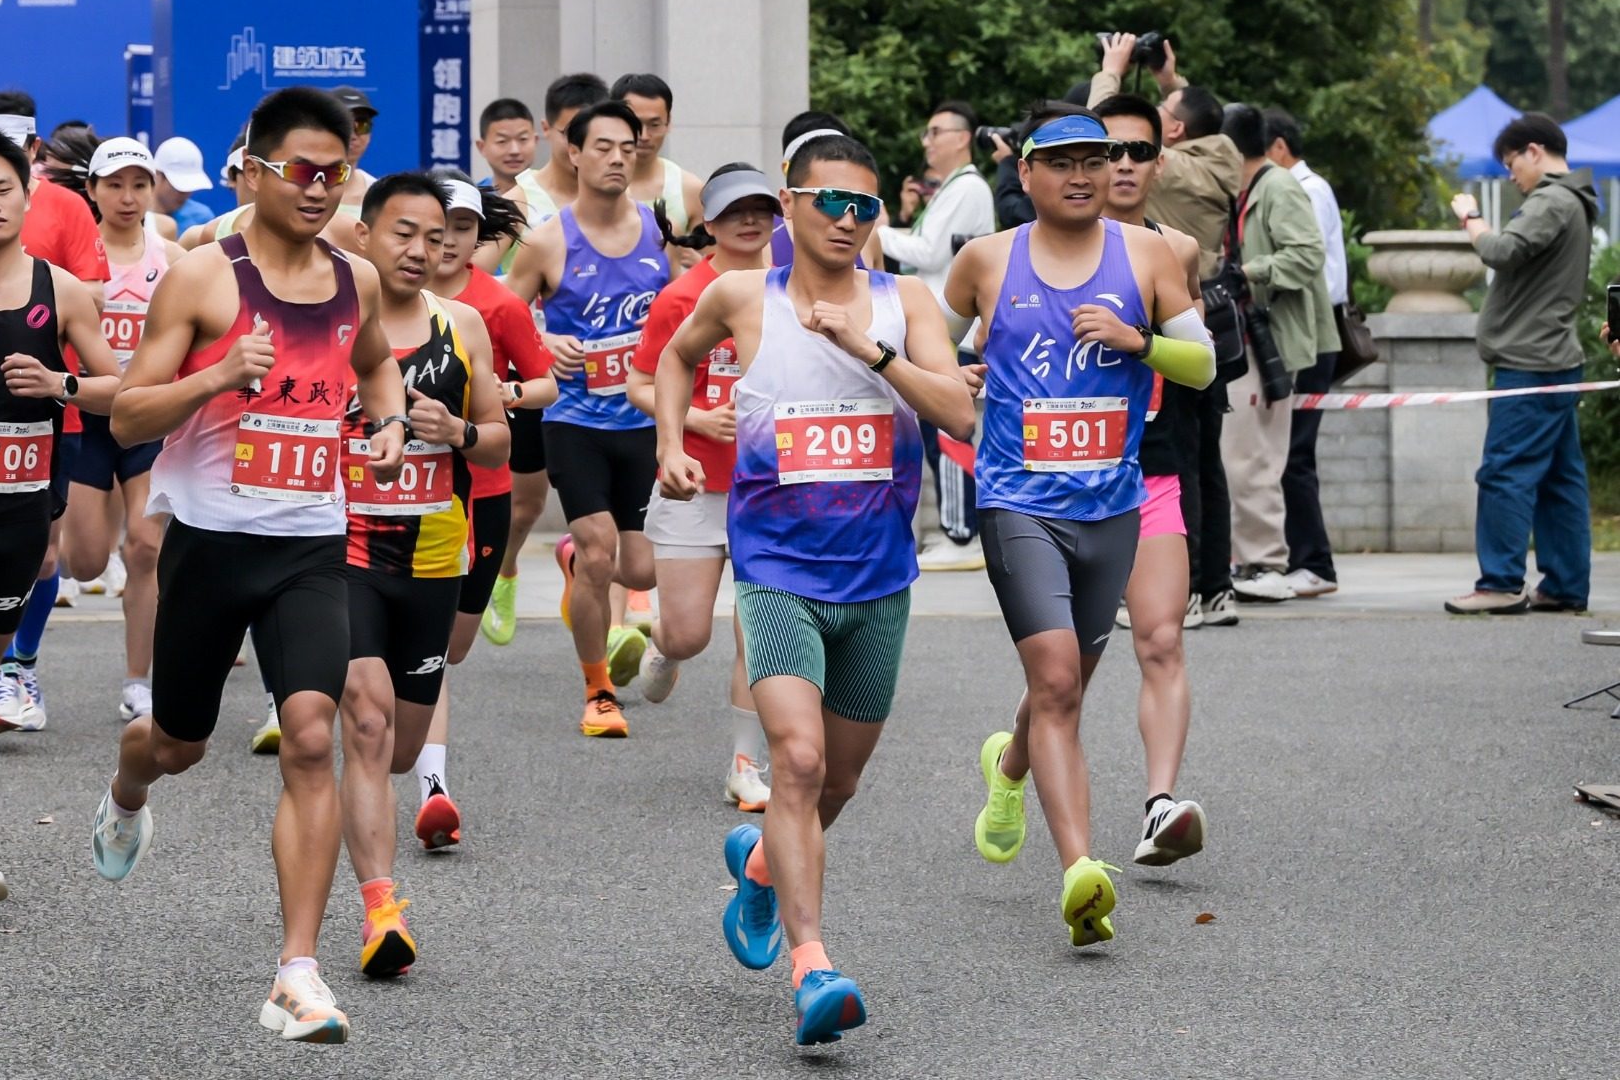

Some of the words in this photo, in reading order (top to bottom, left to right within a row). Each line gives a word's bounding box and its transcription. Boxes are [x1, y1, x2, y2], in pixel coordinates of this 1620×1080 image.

[806, 424, 876, 456] 209
[1049, 419, 1106, 448] 501
[268, 442, 328, 477] 116
